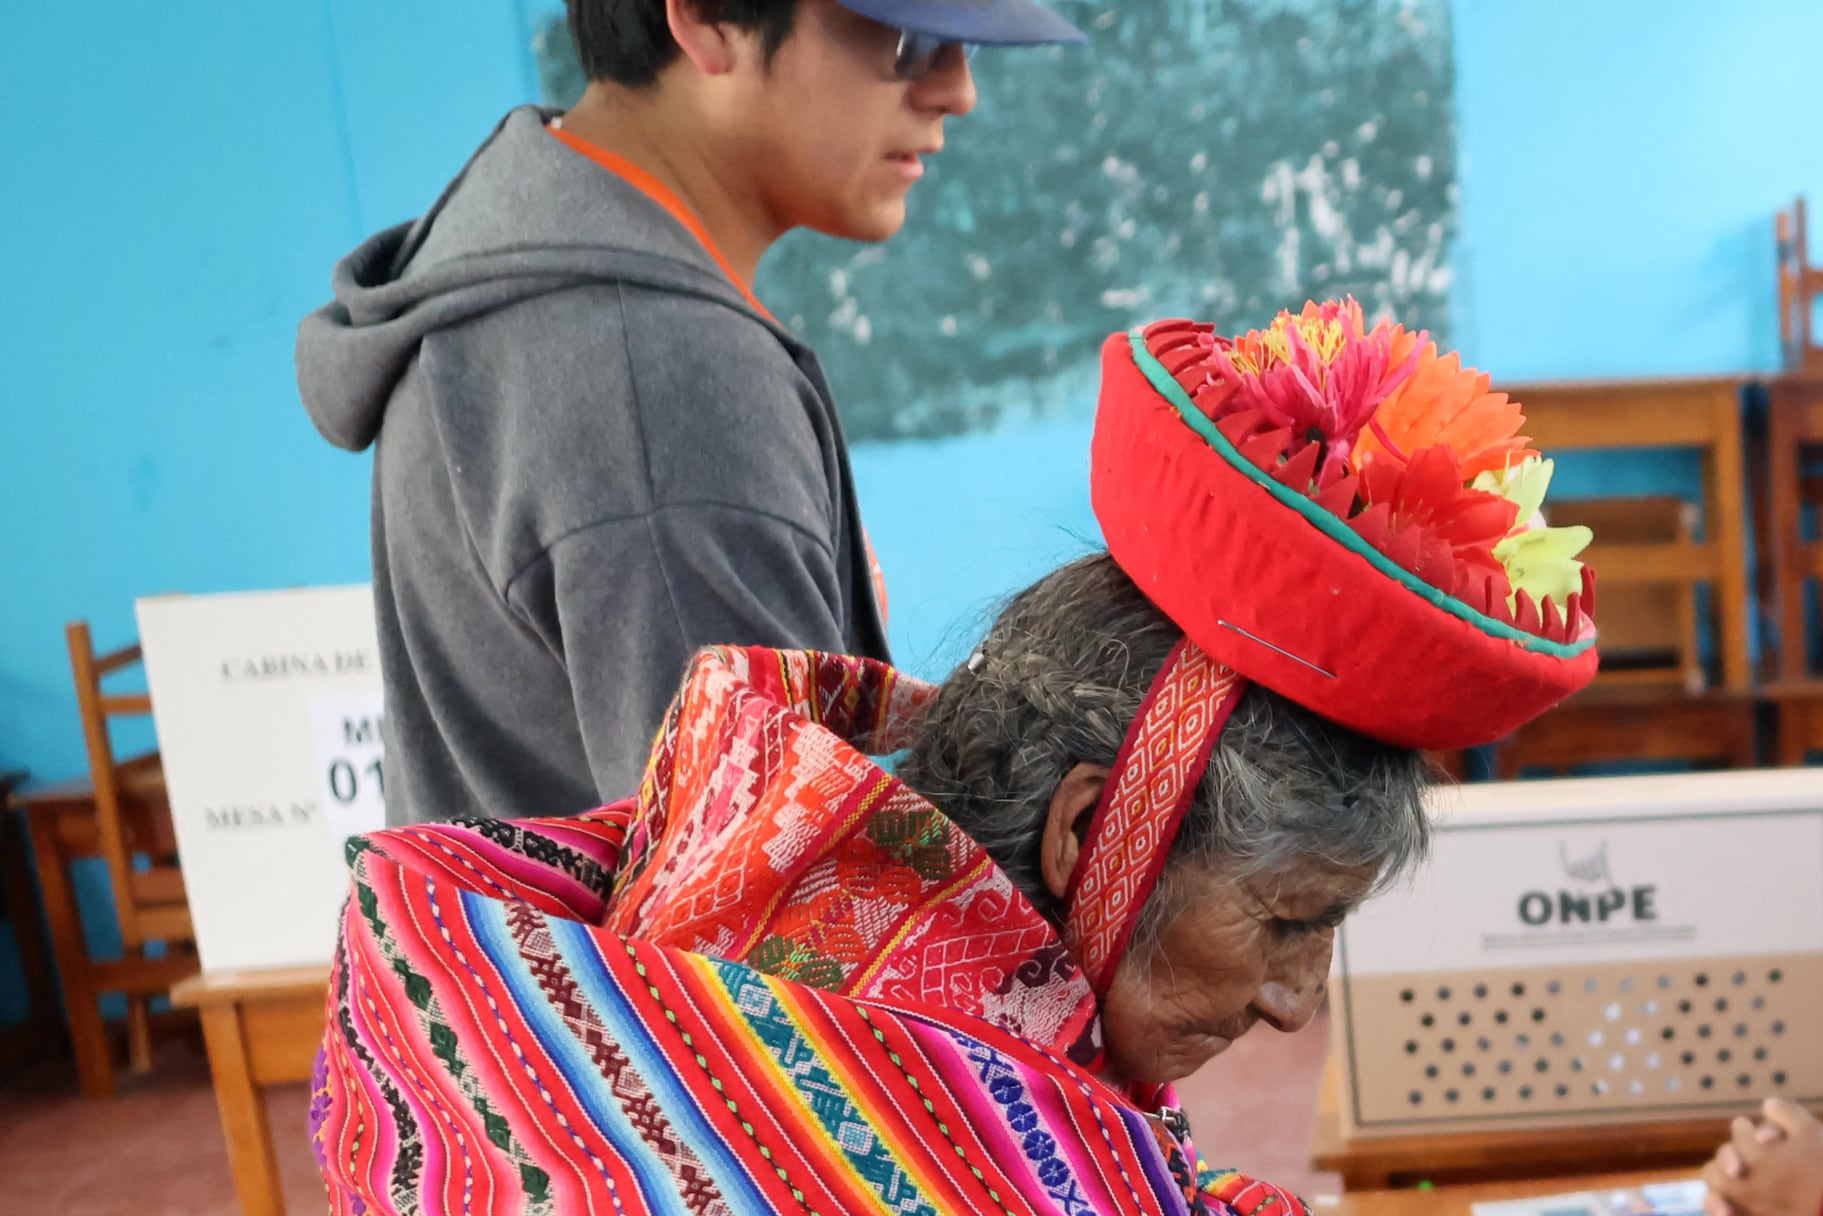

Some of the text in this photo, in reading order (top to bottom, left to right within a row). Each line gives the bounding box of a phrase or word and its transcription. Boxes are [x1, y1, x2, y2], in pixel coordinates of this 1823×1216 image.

[222, 654, 328, 679] CABINA
[206, 803, 284, 826] MESA
[1518, 885, 1657, 926] ONPE
